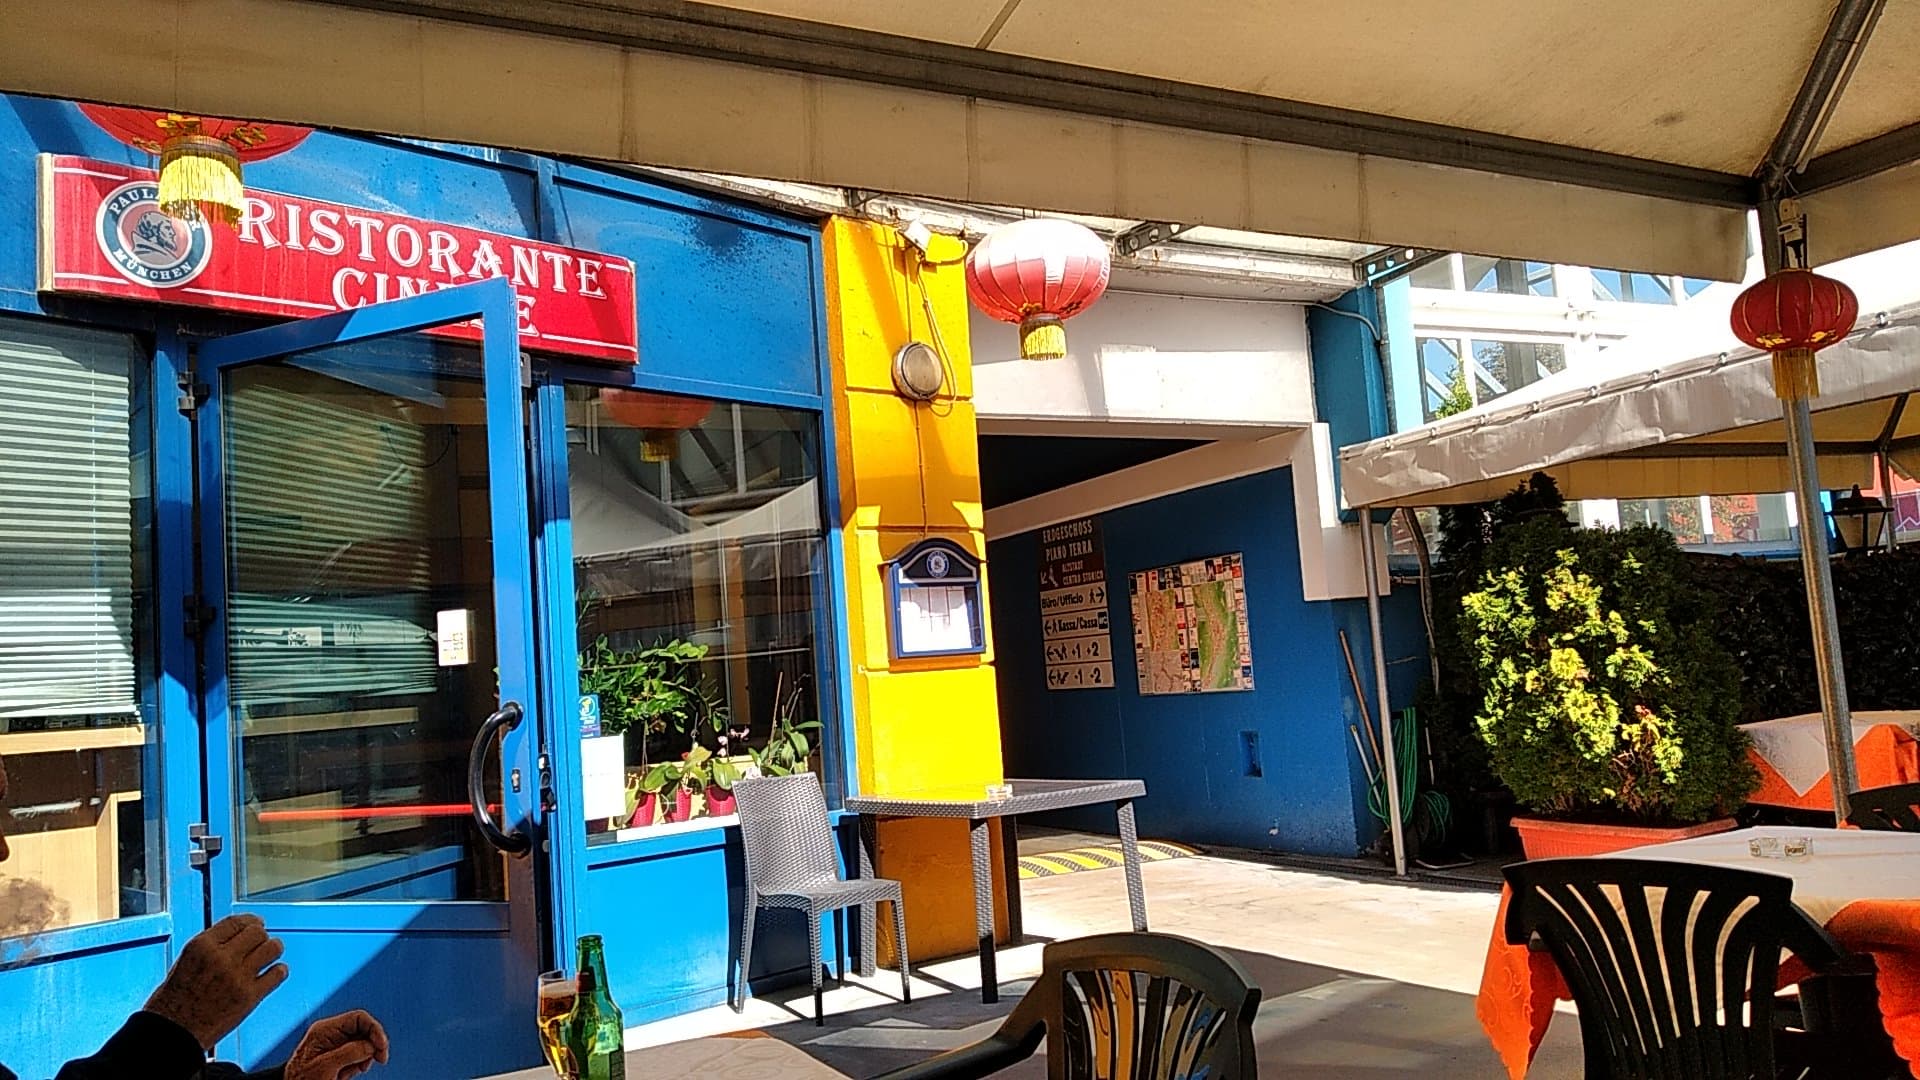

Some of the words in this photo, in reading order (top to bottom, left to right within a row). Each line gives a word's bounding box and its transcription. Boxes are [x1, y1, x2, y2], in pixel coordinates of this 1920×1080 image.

[238, 197, 607, 299] RISTORANTE
[113, 248, 192, 280] MÜNCHEN
[1042, 519, 1093, 544] ERDGESCHOSS
[1045, 544, 1067, 562] PIANO
[1069, 539, 1093, 557] TERRA
